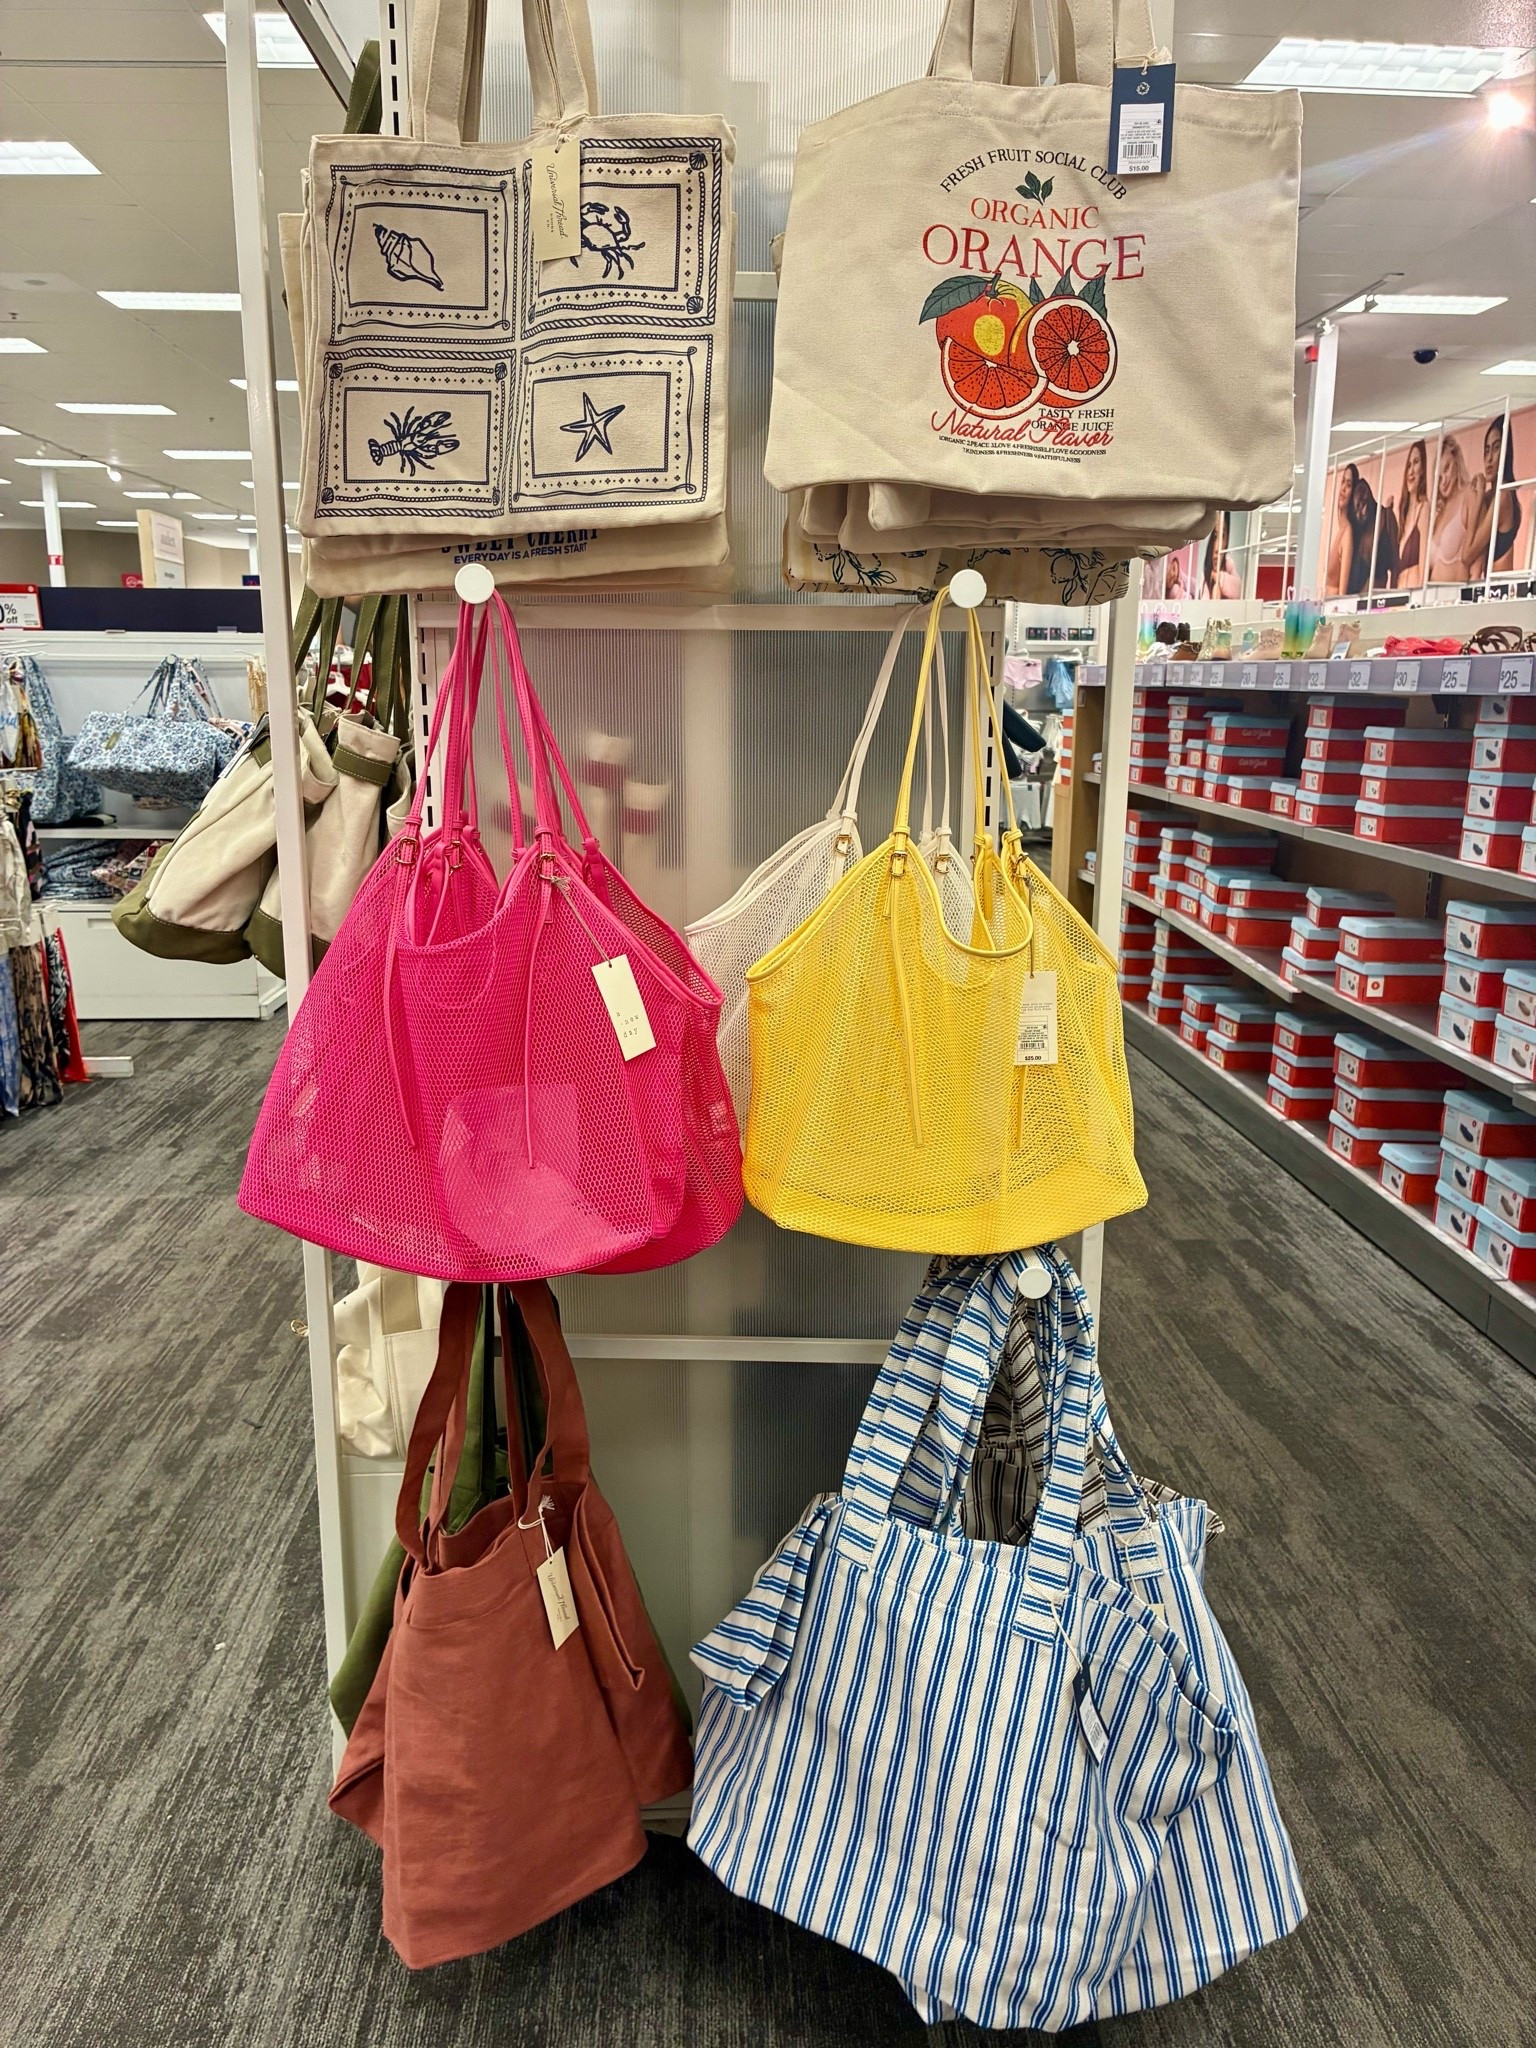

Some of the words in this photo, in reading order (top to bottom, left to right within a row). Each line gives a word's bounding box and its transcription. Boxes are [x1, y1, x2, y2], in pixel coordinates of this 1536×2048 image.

[546, 162, 560, 208] Universal
[940, 156, 986, 193] FRESH
[987, 148, 1031, 164] FRUIT
[1035, 150, 1087, 172] SOCIAL
[1090, 165, 1127, 200] CLUB
[970, 197, 1099, 230] ORGANIC
[922, 224, 1146, 281] ORANGE
[1039, 408, 1075, 419] TASTY
[1078, 408, 1114, 419] FRESH
[931, 405, 1031, 441] Natural
[1029, 416, 1114, 448] Flavor
[1081, 421, 1113, 432] JUICE
[454, 551, 510, 564] EVERYDAY
[511, 550, 521, 560] IS
[522, 550, 530, 559] A
[531, 546, 562, 557] FRESH
[564, 542, 587, 554] START
[6, 616, 18, 624] off
[1442, 671, 1458, 688] $25
[1500, 671, 1518, 689] $25
